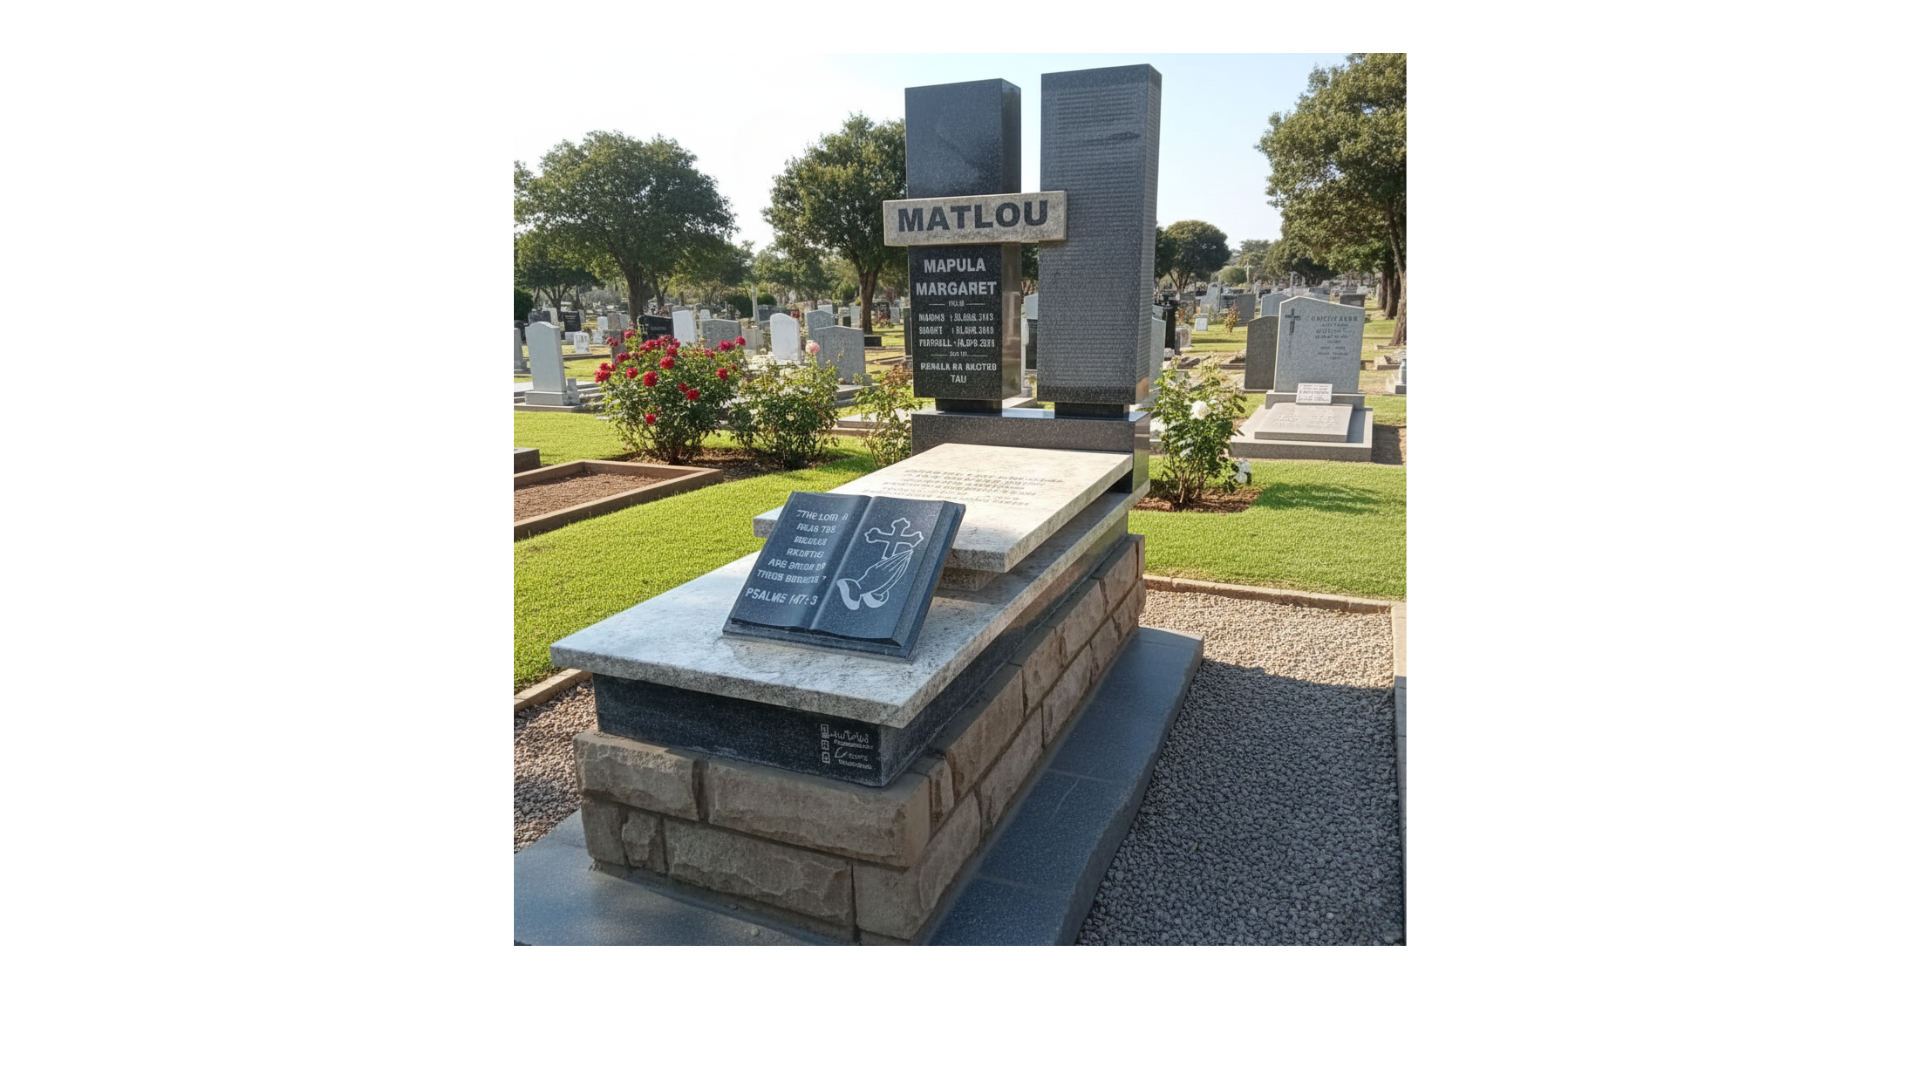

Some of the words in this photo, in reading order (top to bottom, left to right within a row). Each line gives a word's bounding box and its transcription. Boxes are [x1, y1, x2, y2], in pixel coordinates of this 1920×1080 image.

[897, 200, 1048, 232] MATLOU
[924, 258, 986, 273] MAPULA
[916, 281, 997, 295] MARGARET
[950, 374, 968, 384] TAU
